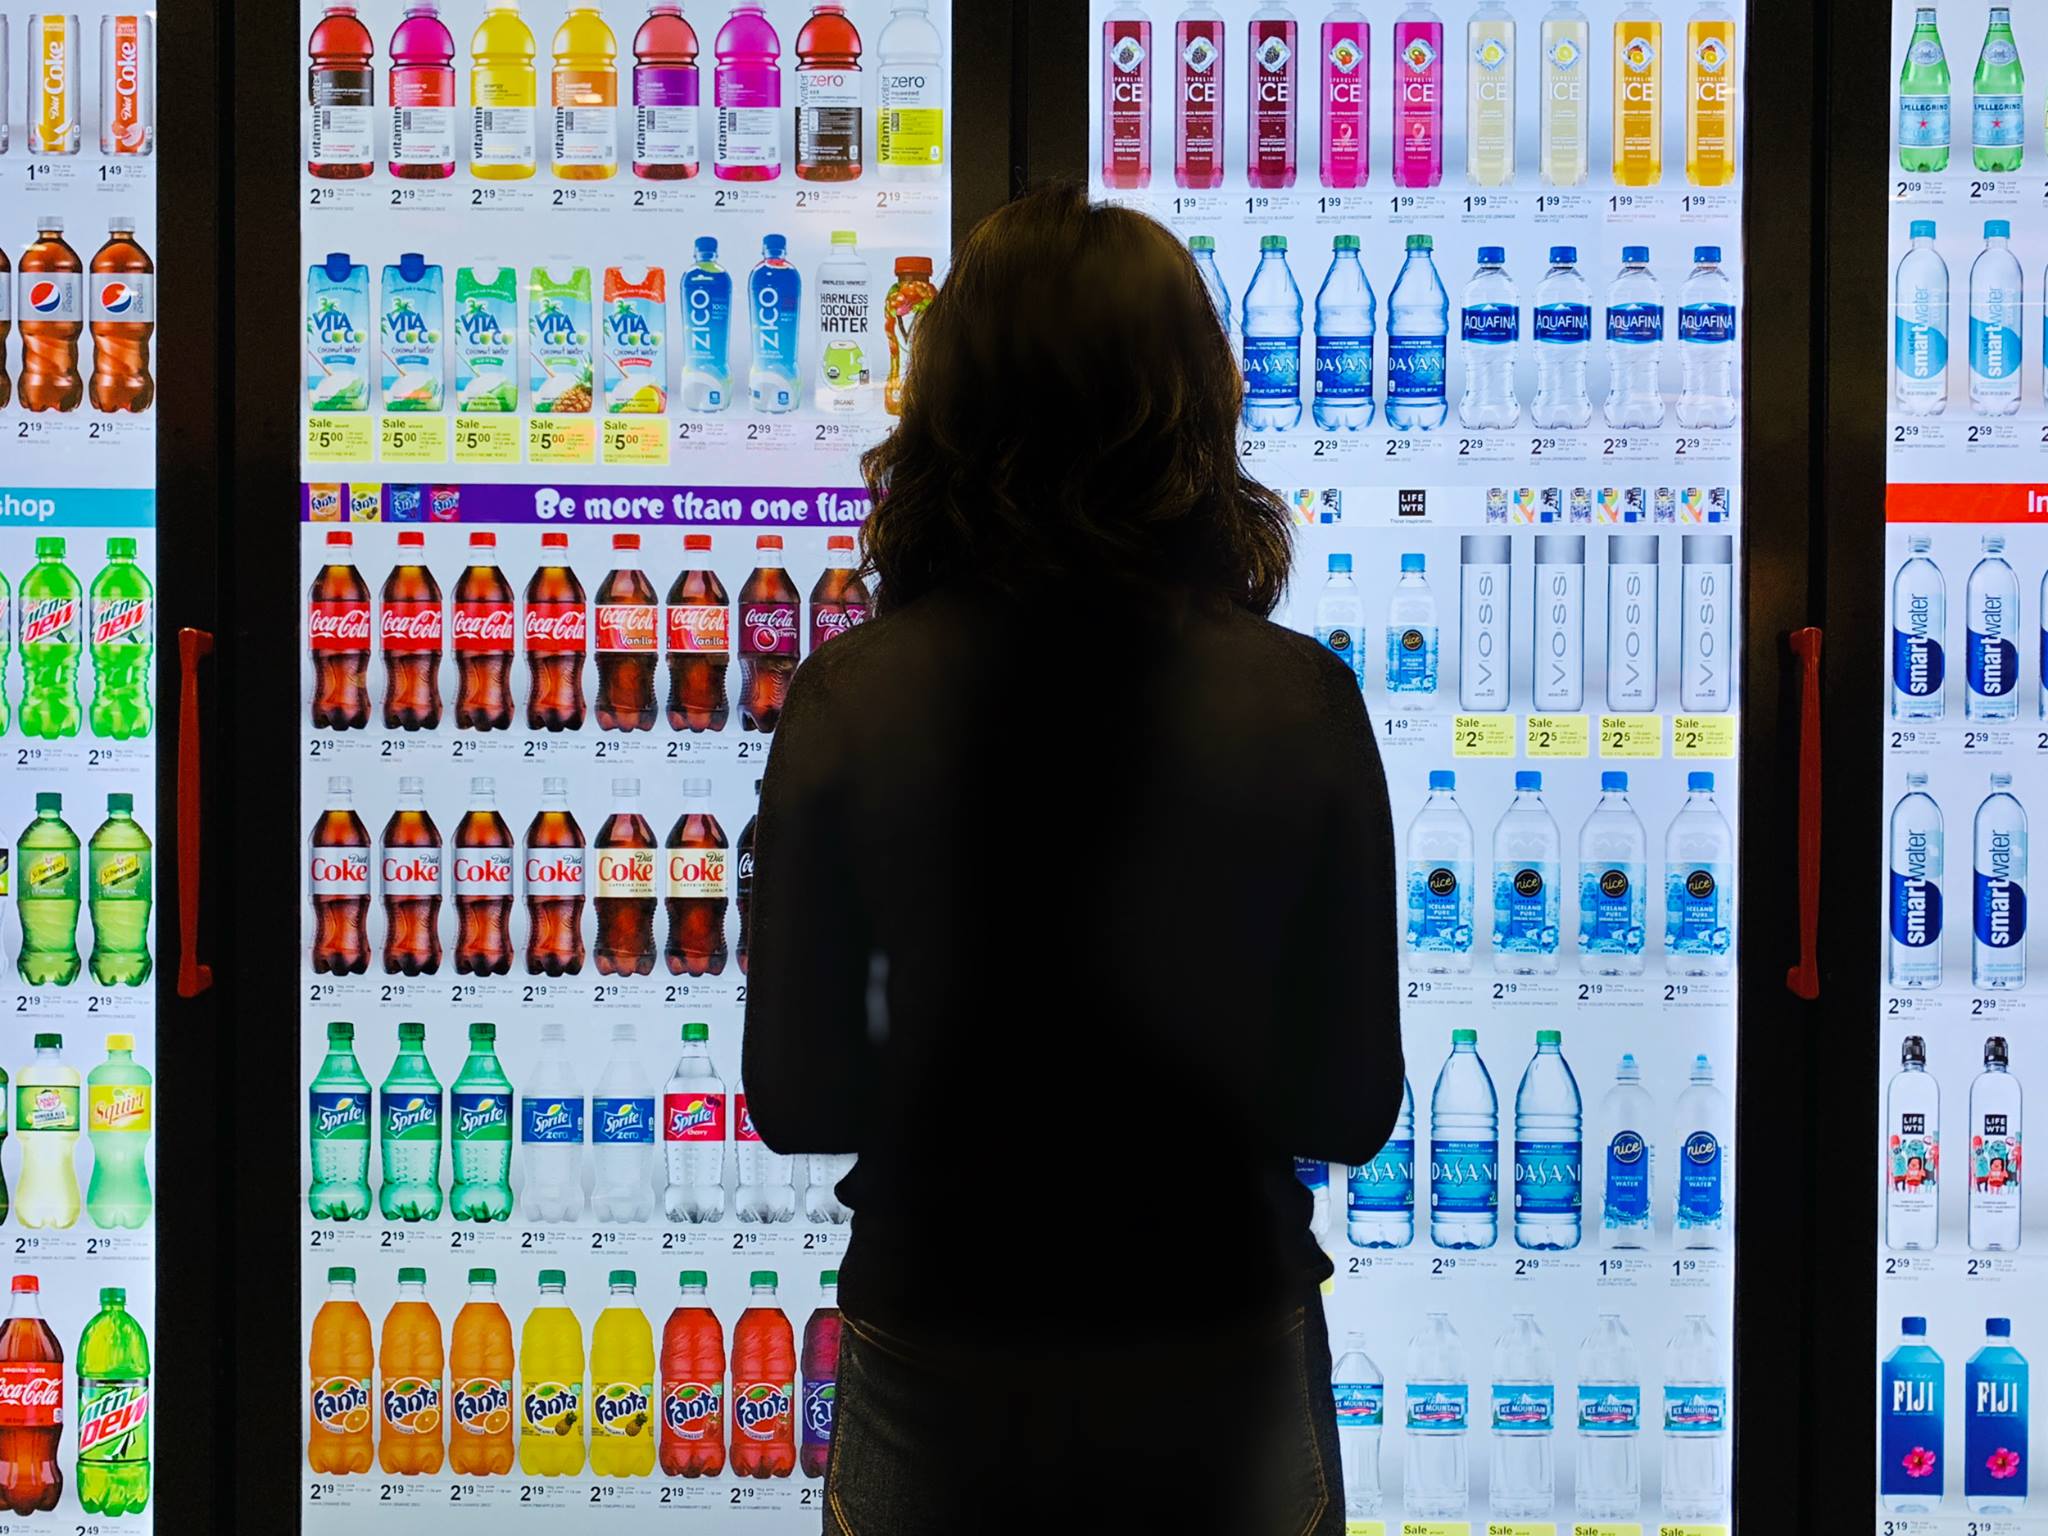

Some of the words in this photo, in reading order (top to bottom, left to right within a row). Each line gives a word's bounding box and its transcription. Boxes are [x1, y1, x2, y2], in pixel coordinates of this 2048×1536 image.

[44, 41, 64, 95] Coke
[117, 42, 136, 95] Coke
[809, 74, 844, 87] zero
[890, 76, 925, 89] zero
[1112, 83, 1144, 102] ICE
[1185, 83, 1217, 102] ICE
[1476, 83, 1508, 101] ICE
[1623, 83, 1656, 101] ICE
[1696, 83, 1728, 101] ICE
[1330, 84, 1362, 102] ICE
[820, 294, 868, 304] HARMLESS
[820, 305, 869, 316] COCONUT
[312, 309, 354, 332] VITA
[461, 310, 501, 334] VITA
[609, 311, 650, 334] VITA
[690, 289, 710, 349] ZICO
[758, 287, 779, 349] ZICO
[820, 317, 868, 333] WATER
[1463, 313, 1518, 330] AQUAFINA
[1536, 313, 1589, 330] AQUAFINA
[1680, 313, 1733, 330] AQUAFINA
[1243, 355, 1299, 374] DASANI
[1316, 355, 1372, 374] DASANI
[309, 418, 332, 429] Sale
[456, 419, 479, 430] Sale
[535, 488, 576, 520] Be
[584, 496, 664, 521] more
[672, 491, 743, 521] than
[751, 497, 809, 521] one
[816, 491, 873, 523] flav
[1401, 493, 1424, 502] LIFE
[1401, 503, 1424, 512] WTR
[310, 609, 370, 640] Coca-Cola
[381, 609, 441, 640] Coca-Cola
[523, 610, 586, 641] Coca-Cola
[745, 608, 797, 629] Coca-Cola
[1907, 593, 1929, 694] smartwater
[1980, 593, 2002, 694] smartwater
[1456, 718, 1480, 728] Sale
[1675, 718, 1699, 729] Sale
[311, 857, 368, 882] Coke
[382, 858, 439, 882] Coke
[525, 858, 583, 882] Coke
[599, 856, 653, 882] Coke
[1904, 829, 1926, 945] smartwater
[96, 1092, 144, 1125] Squirt
[319, 1103, 362, 1132] Sprite
[390, 1104, 433, 1132] Sprite
[460, 1104, 504, 1133] Sprite
[534, 1107, 568, 1133] Sprite
[673, 1107, 713, 1134] Sprite
[1903, 1116, 1924, 1125] LIFE
[1903, 1125, 1924, 1133] WTR
[1432, 1157, 1497, 1186] DASANI
[313, 1385, 368, 1424] Fanta
[384, 1386, 438, 1424] Fanta
[524, 1388, 578, 1425] Fanta
[595, 1391, 648, 1425] Fanta
[1892, 1380, 1934, 1412] FIJI
[1976, 1381, 2018, 1413] FIJI
[665, 1391, 719, 1427] Fanta
[1404, 1524, 1427, 1535] Sale
